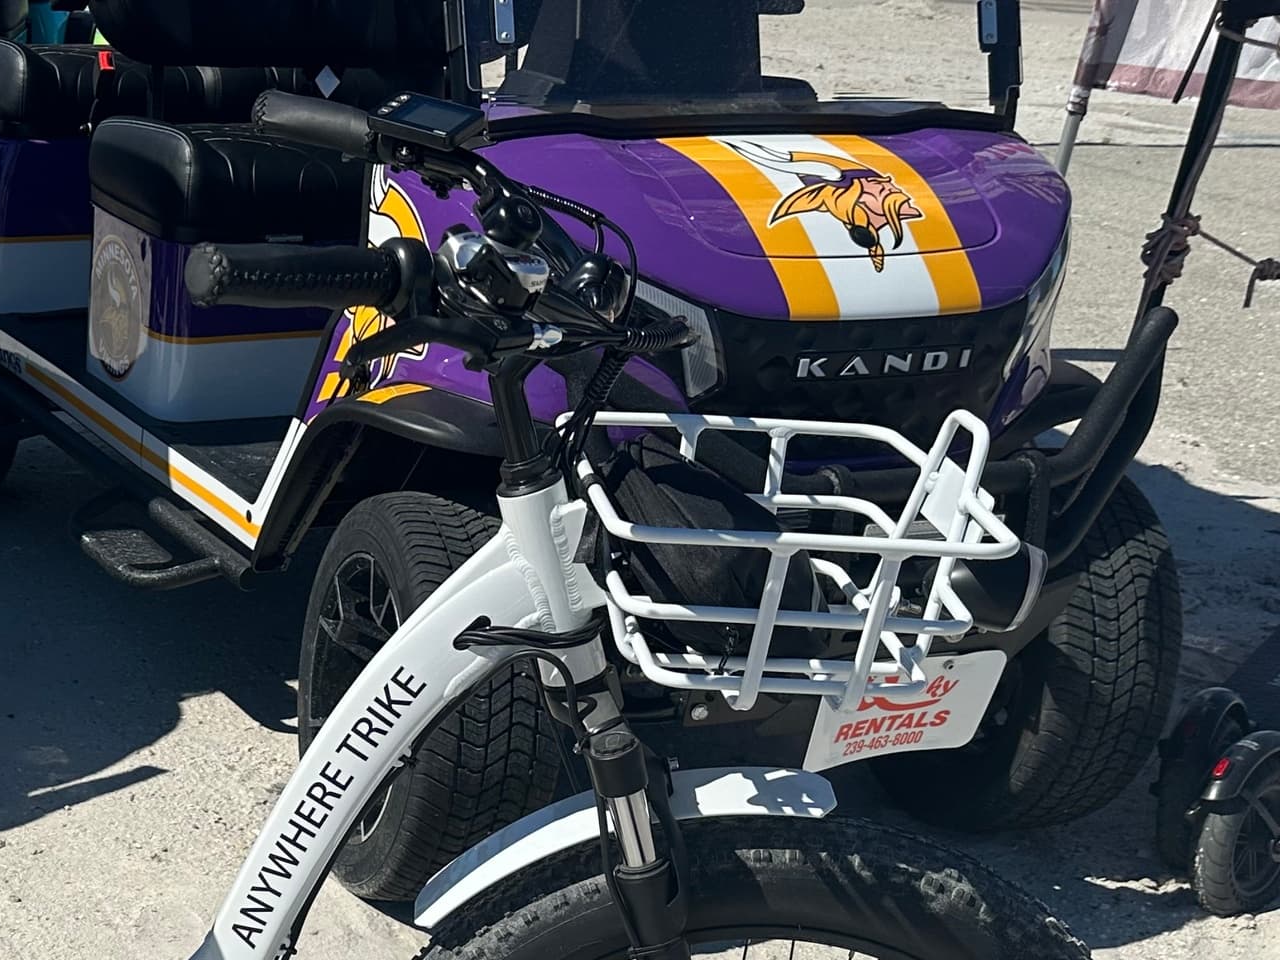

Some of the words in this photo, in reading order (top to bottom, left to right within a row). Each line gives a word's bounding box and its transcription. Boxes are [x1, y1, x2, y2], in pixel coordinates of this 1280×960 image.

[796, 349, 971, 378] KANDI
[834, 710, 951, 744] RENTALS
[842, 731, 924, 757] 239-463-8000
[231, 760, 355, 949] ANYWHERE
[335, 665, 428, 761] TRIKE
